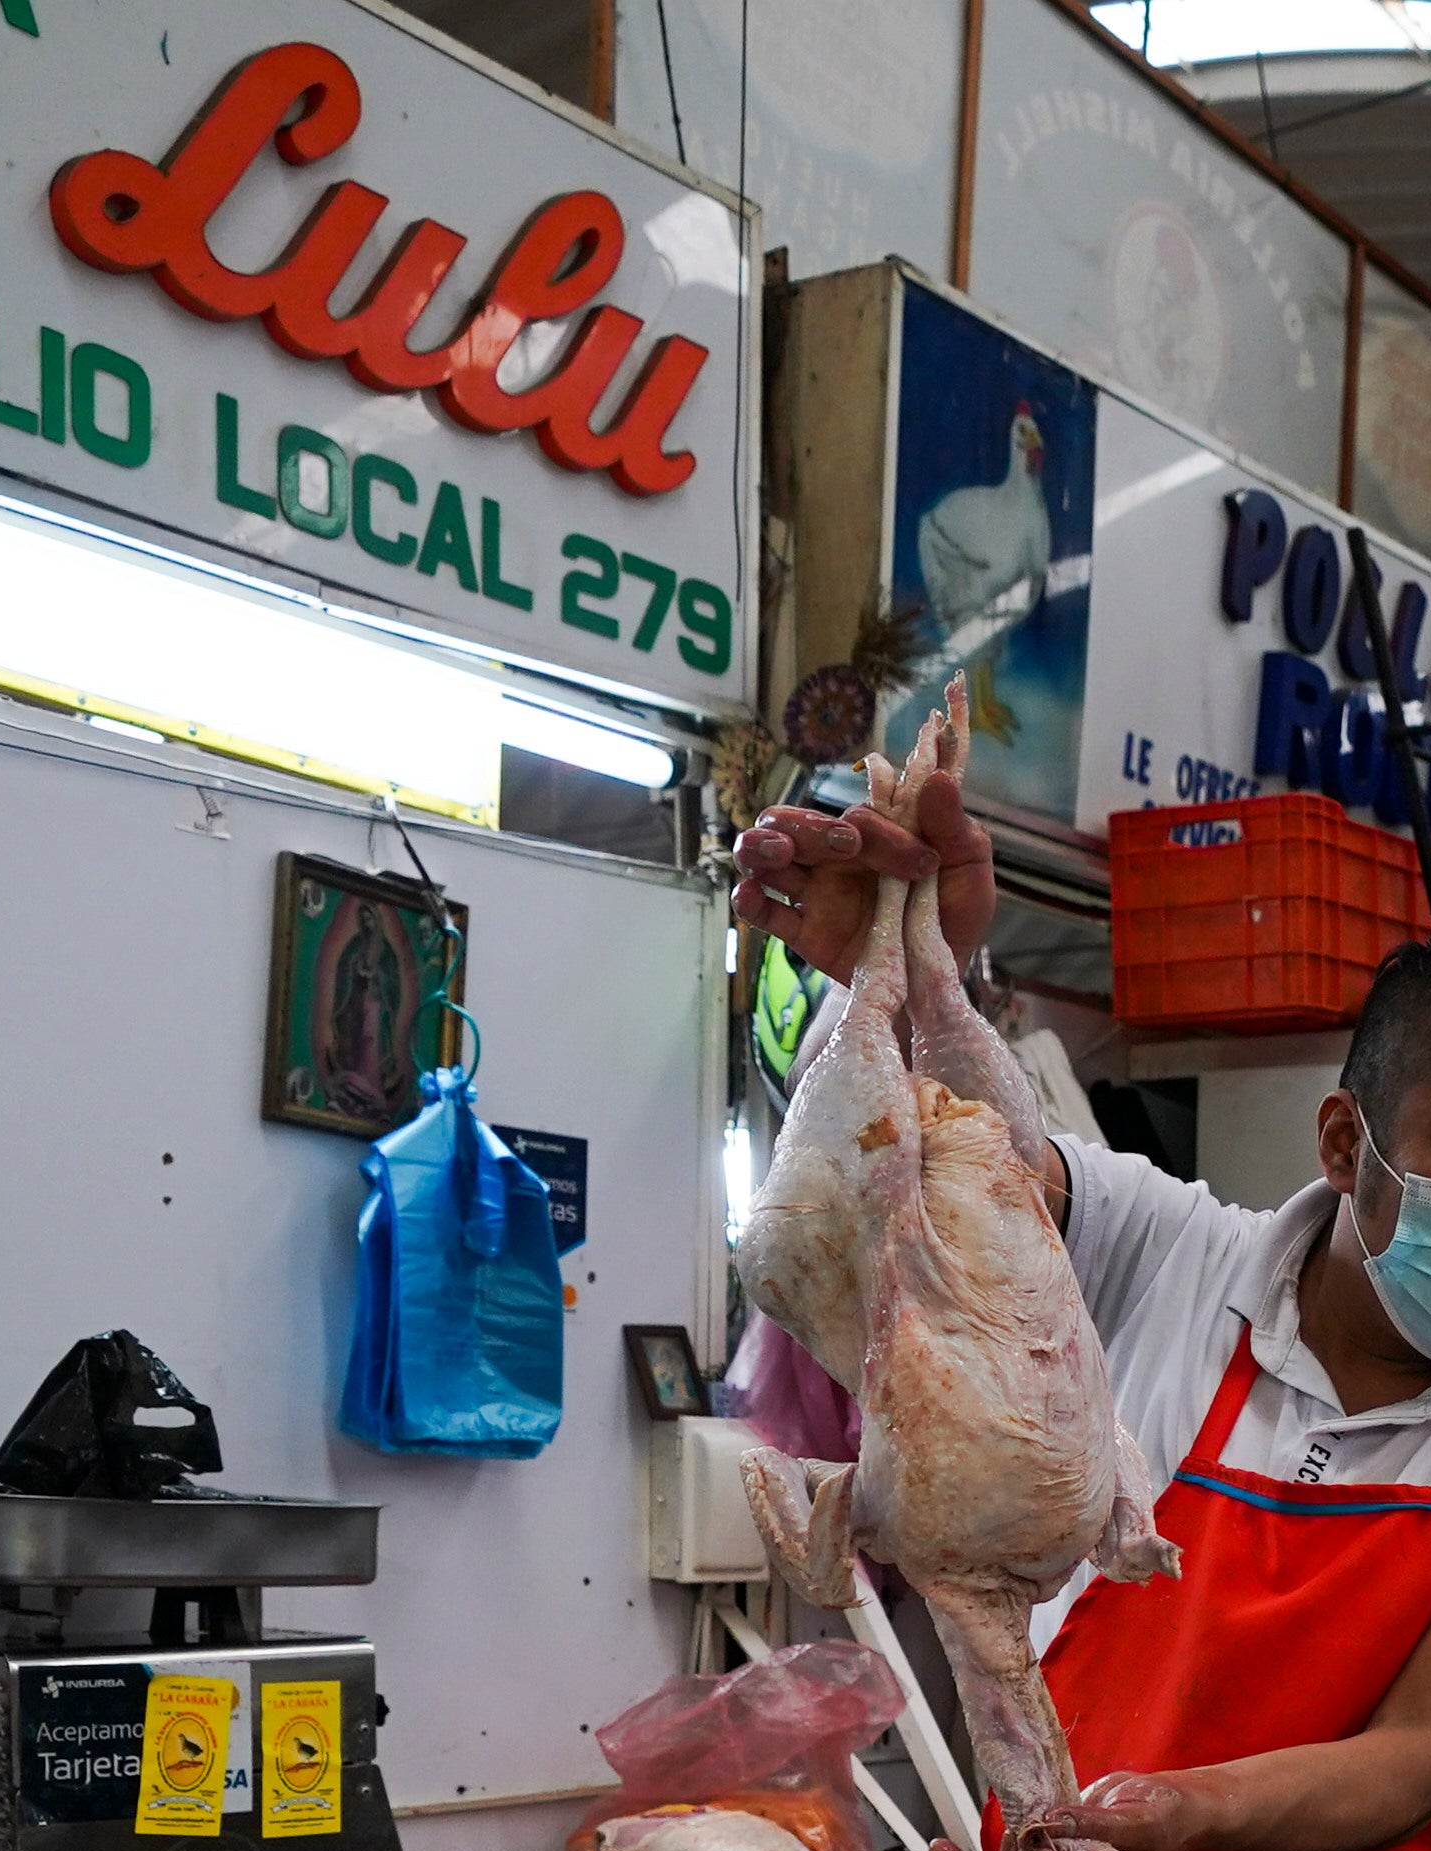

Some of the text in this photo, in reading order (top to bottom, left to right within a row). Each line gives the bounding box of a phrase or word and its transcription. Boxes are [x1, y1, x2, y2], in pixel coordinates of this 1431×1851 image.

[49, 41, 709, 497] Lulu
[215, 392, 533, 614] LOCAL
[559, 531, 733, 676] 279
[1123, 731, 1154, 786] LE
[65, 1678, 126, 1689] INBURSA
[36, 1722, 145, 1746] Aceptamo
